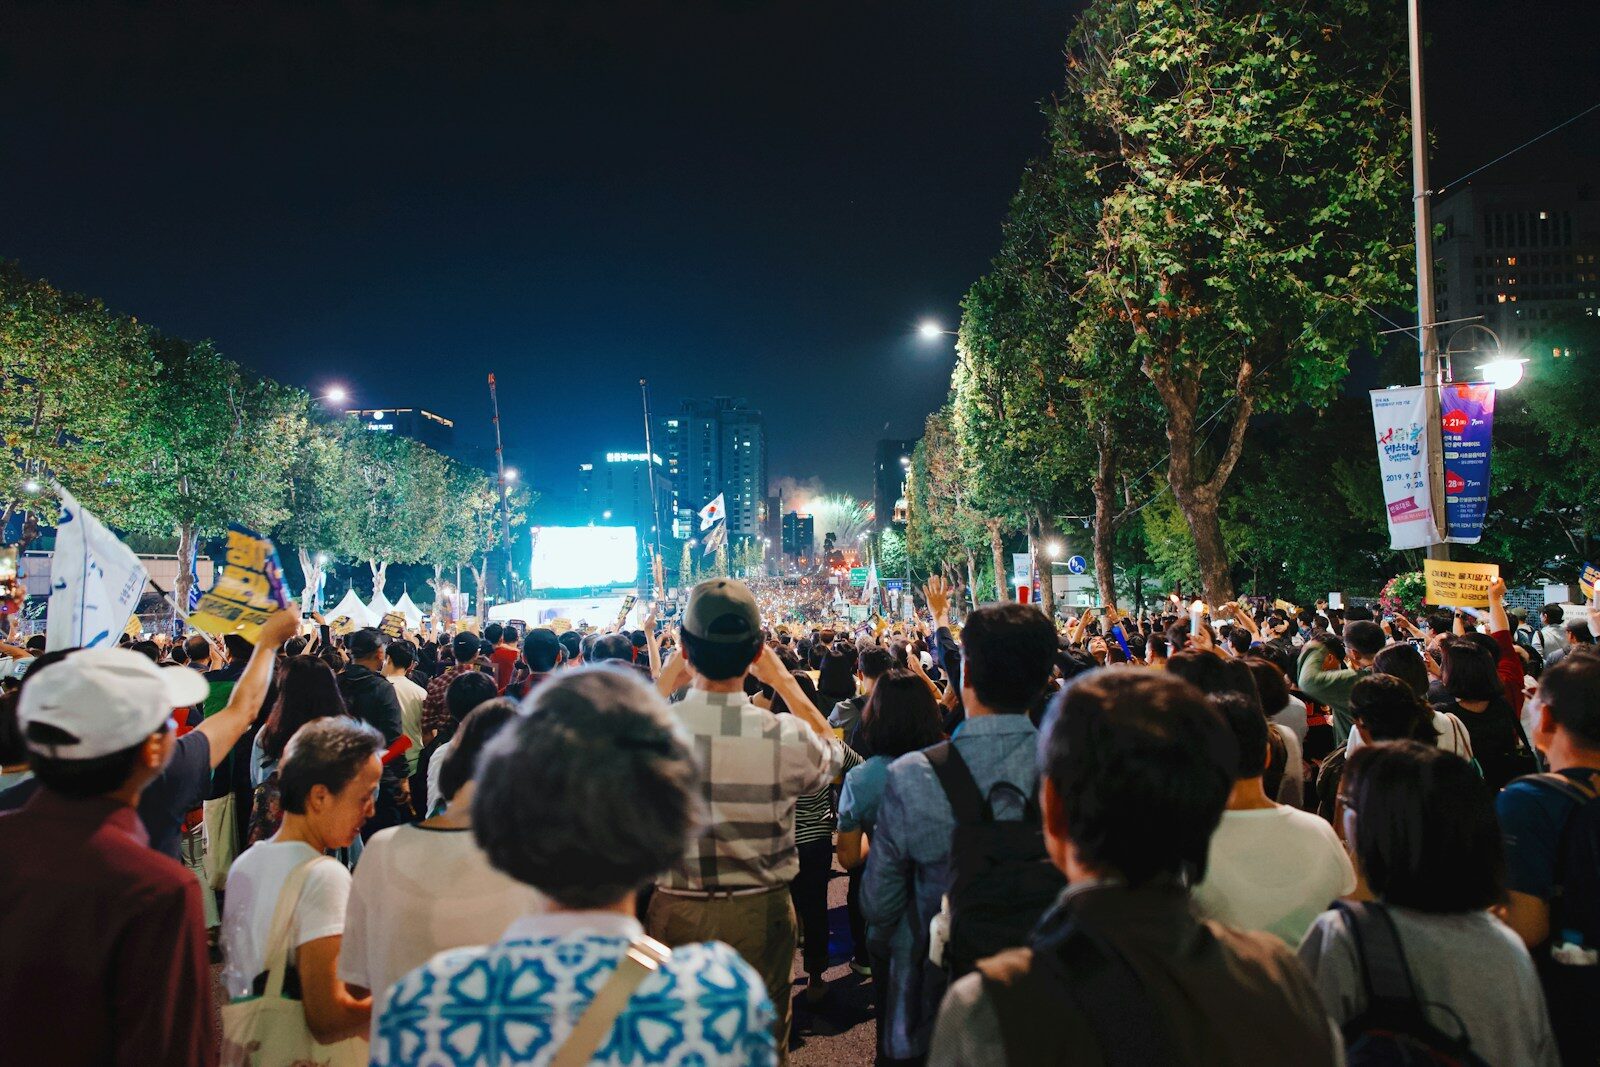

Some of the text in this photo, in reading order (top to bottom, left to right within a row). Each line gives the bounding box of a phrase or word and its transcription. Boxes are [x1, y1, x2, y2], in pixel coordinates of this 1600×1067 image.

[1471, 418, 1484, 426] 7pm
[1386, 474, 1404, 482] 2019.
[1413, 471, 1422, 479] 21
[1414, 480, 1424, 488] 28
[1467, 479, 1481, 487] 7pm
